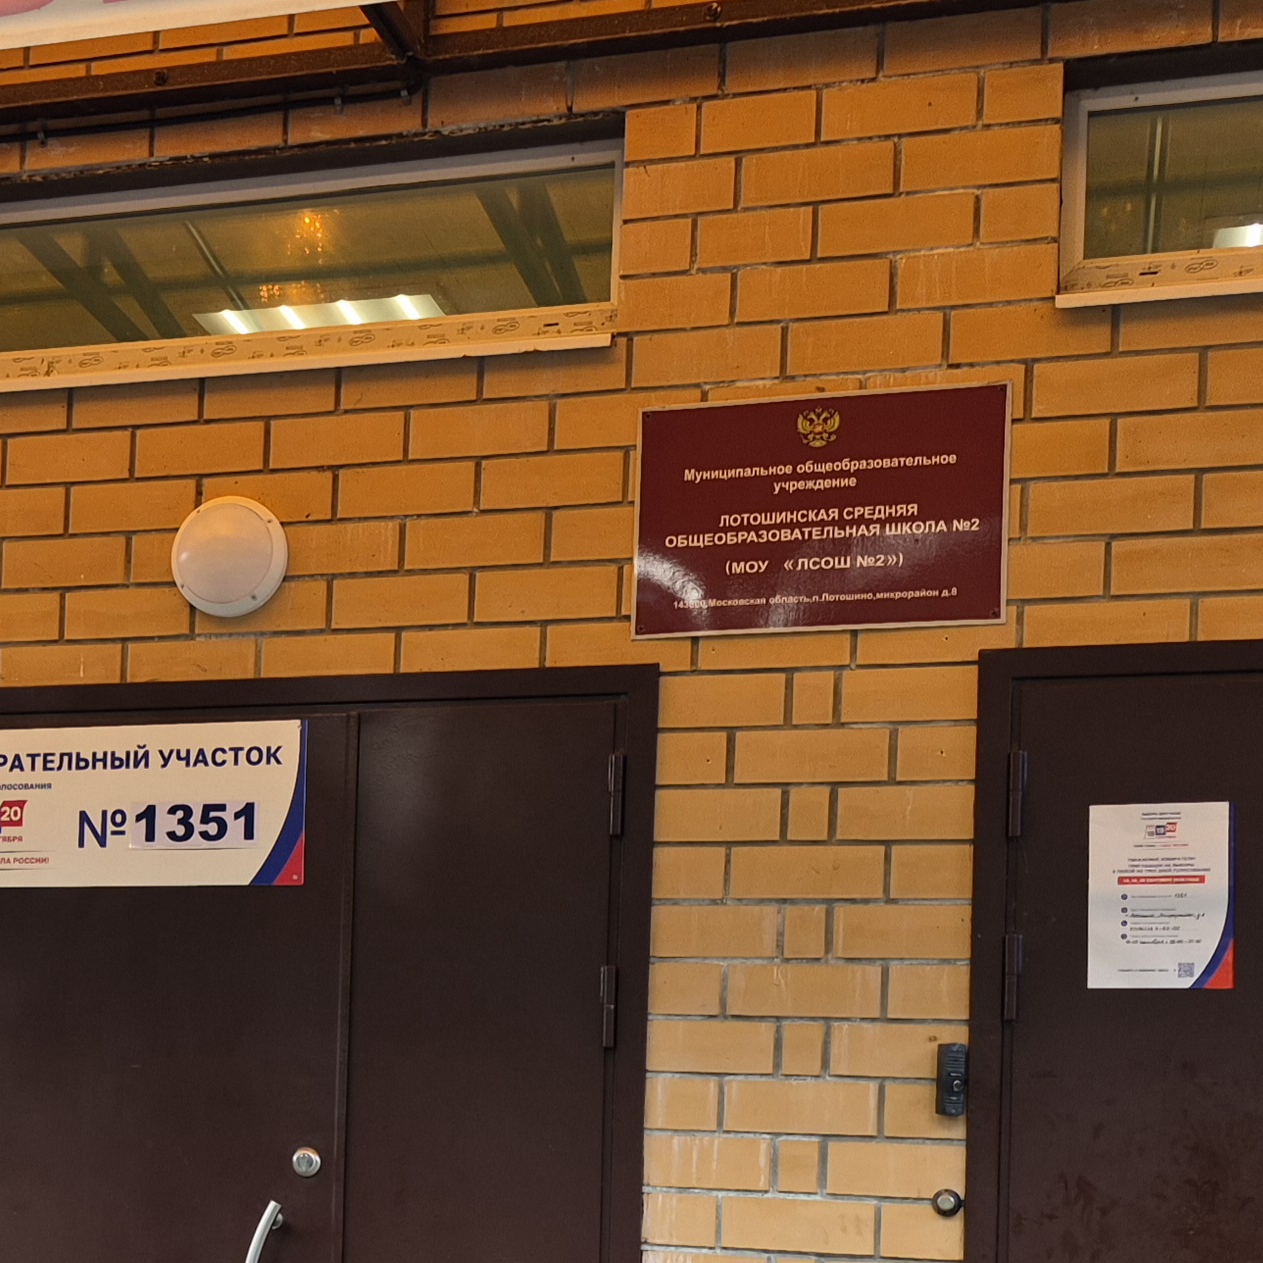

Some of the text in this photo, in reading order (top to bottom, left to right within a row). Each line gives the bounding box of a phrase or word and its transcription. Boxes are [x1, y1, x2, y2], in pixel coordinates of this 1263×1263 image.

[684, 454, 957, 484] Муниципальное общеобразовательное
[773, 476, 857, 495] учреждение
[719, 503, 919, 528] ЛОТОШИНСКАЯ СРЕДНЯЯ
[665, 517, 980, 549] ОБЩЕОБРАЗОВАТЕЛЬНАЯ ШКОЛА №2
[725, 552, 904, 576] (МОУ «ЛСОШ №2»)
[159, 745, 284, 769] УЧАСТОК
[0, 806, 22, 821] 20
